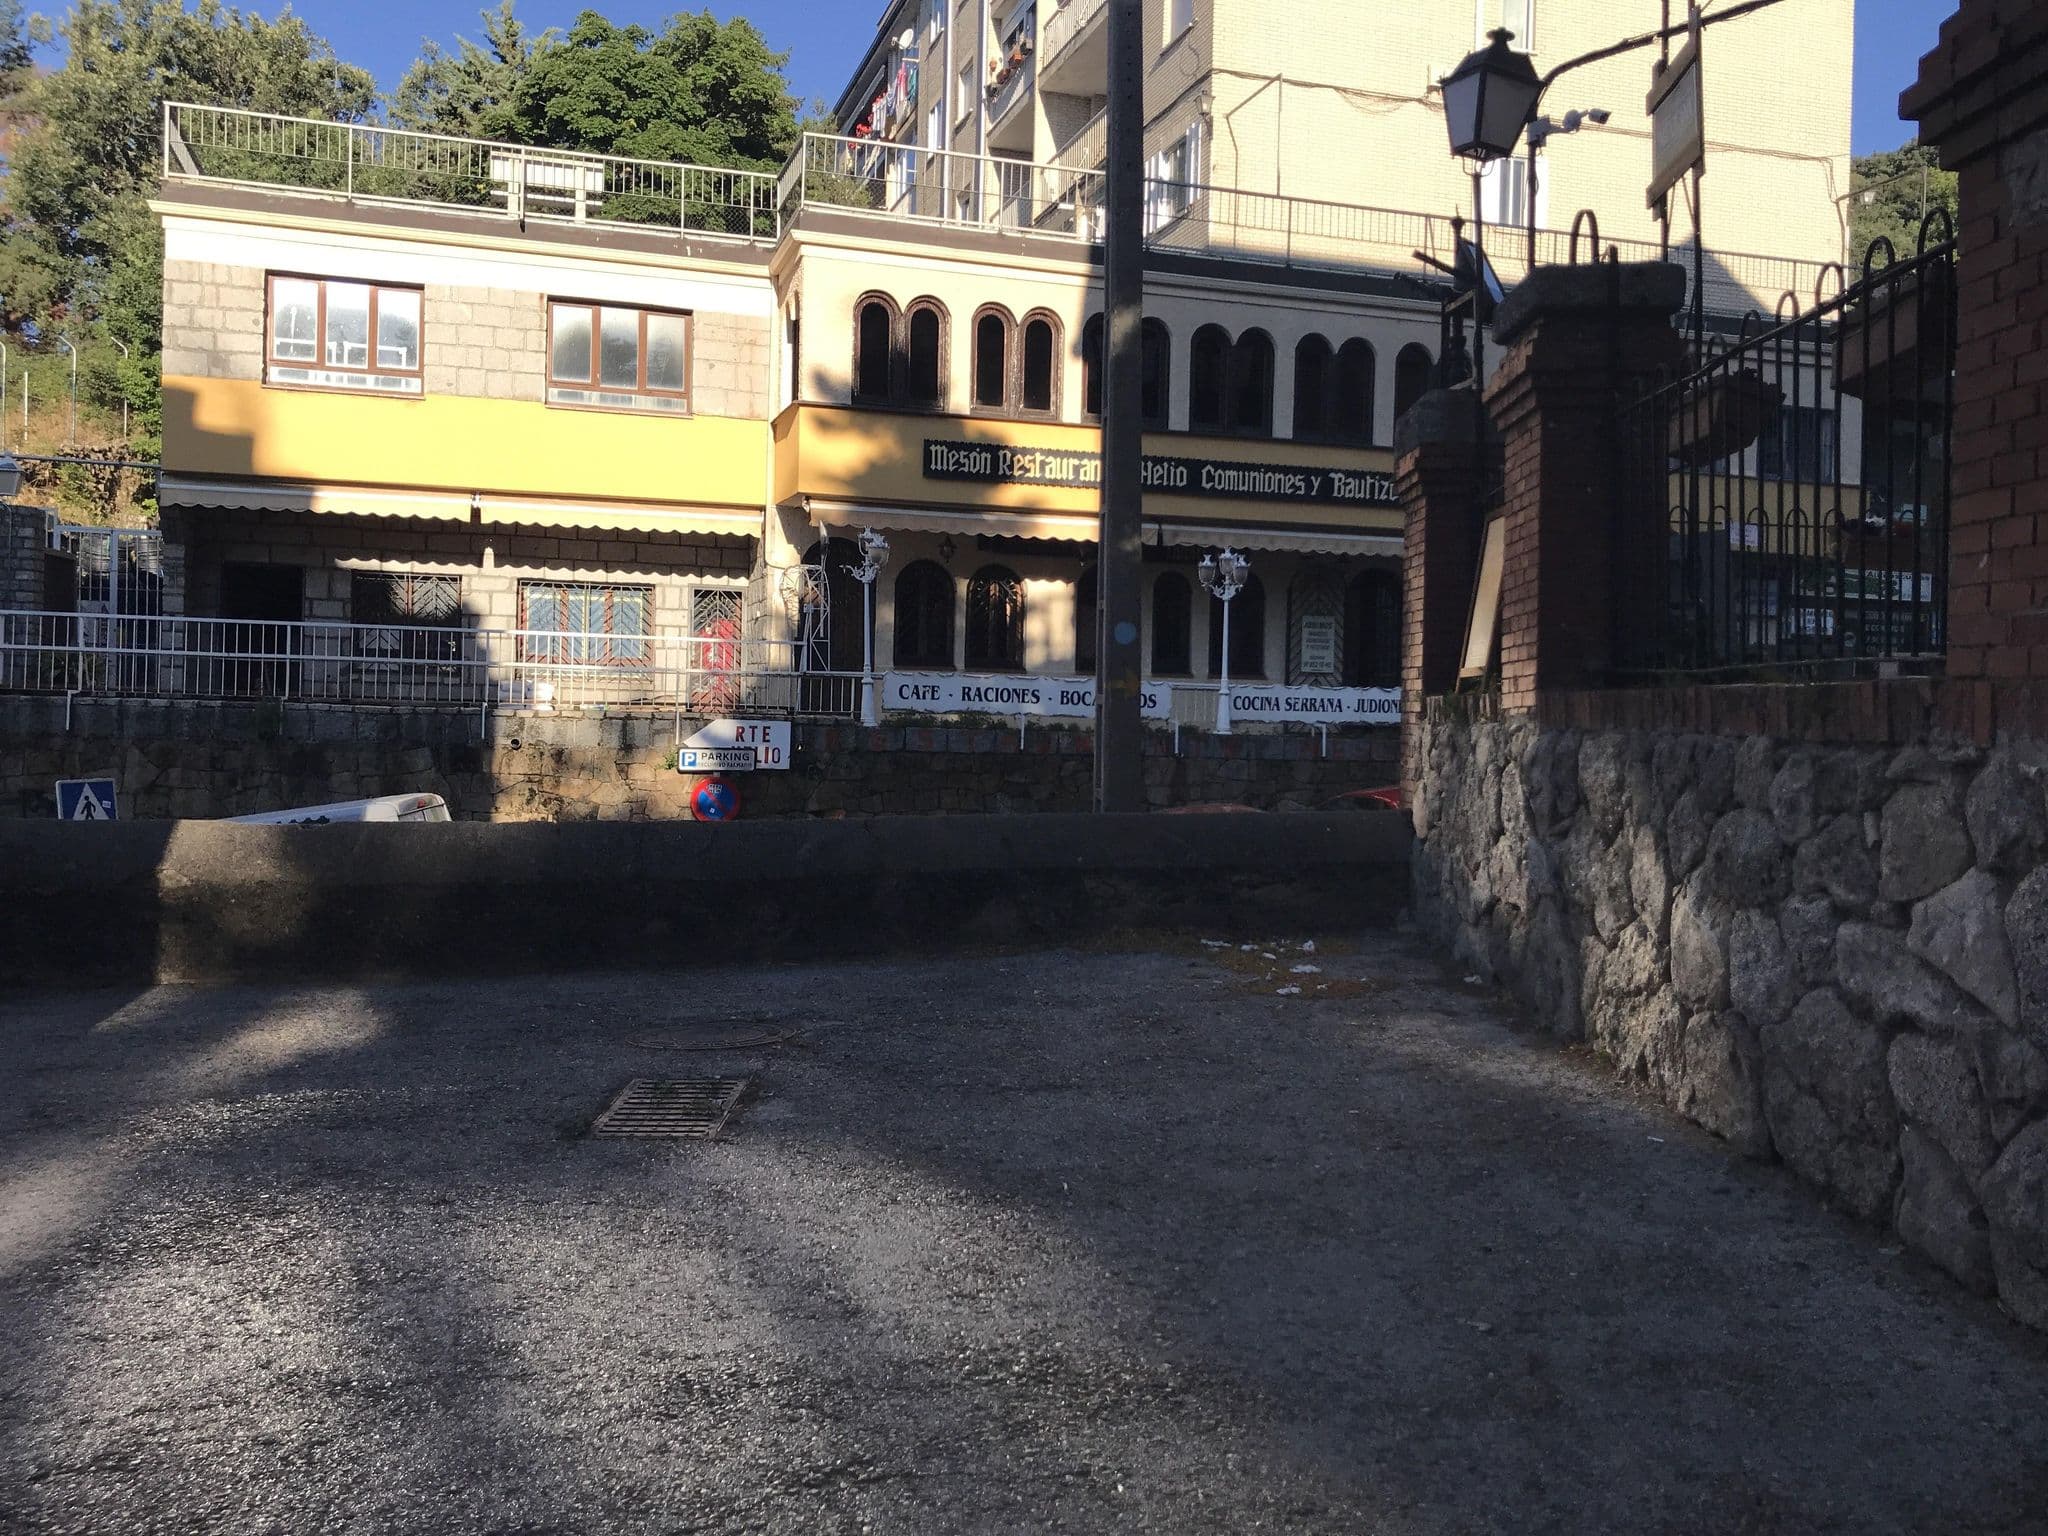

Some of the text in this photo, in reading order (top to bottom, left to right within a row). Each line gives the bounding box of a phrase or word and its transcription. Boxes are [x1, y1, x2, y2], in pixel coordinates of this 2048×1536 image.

[929, 443, 992, 474] Mesón
[998, 449, 1101, 482] Restauran
[1141, 461, 1187, 488] Helio
[1201, 464, 1305, 496] Comuniones
[898, 683, 941, 701] CAFE
[961, 685, 1041, 705] RACIONES
[1233, 695, 1280, 712] COCINA
[1284, 696, 1343, 713] SERRANA
[735, 725, 772, 743] RTE
[701, 752, 750, 761] PARKING
